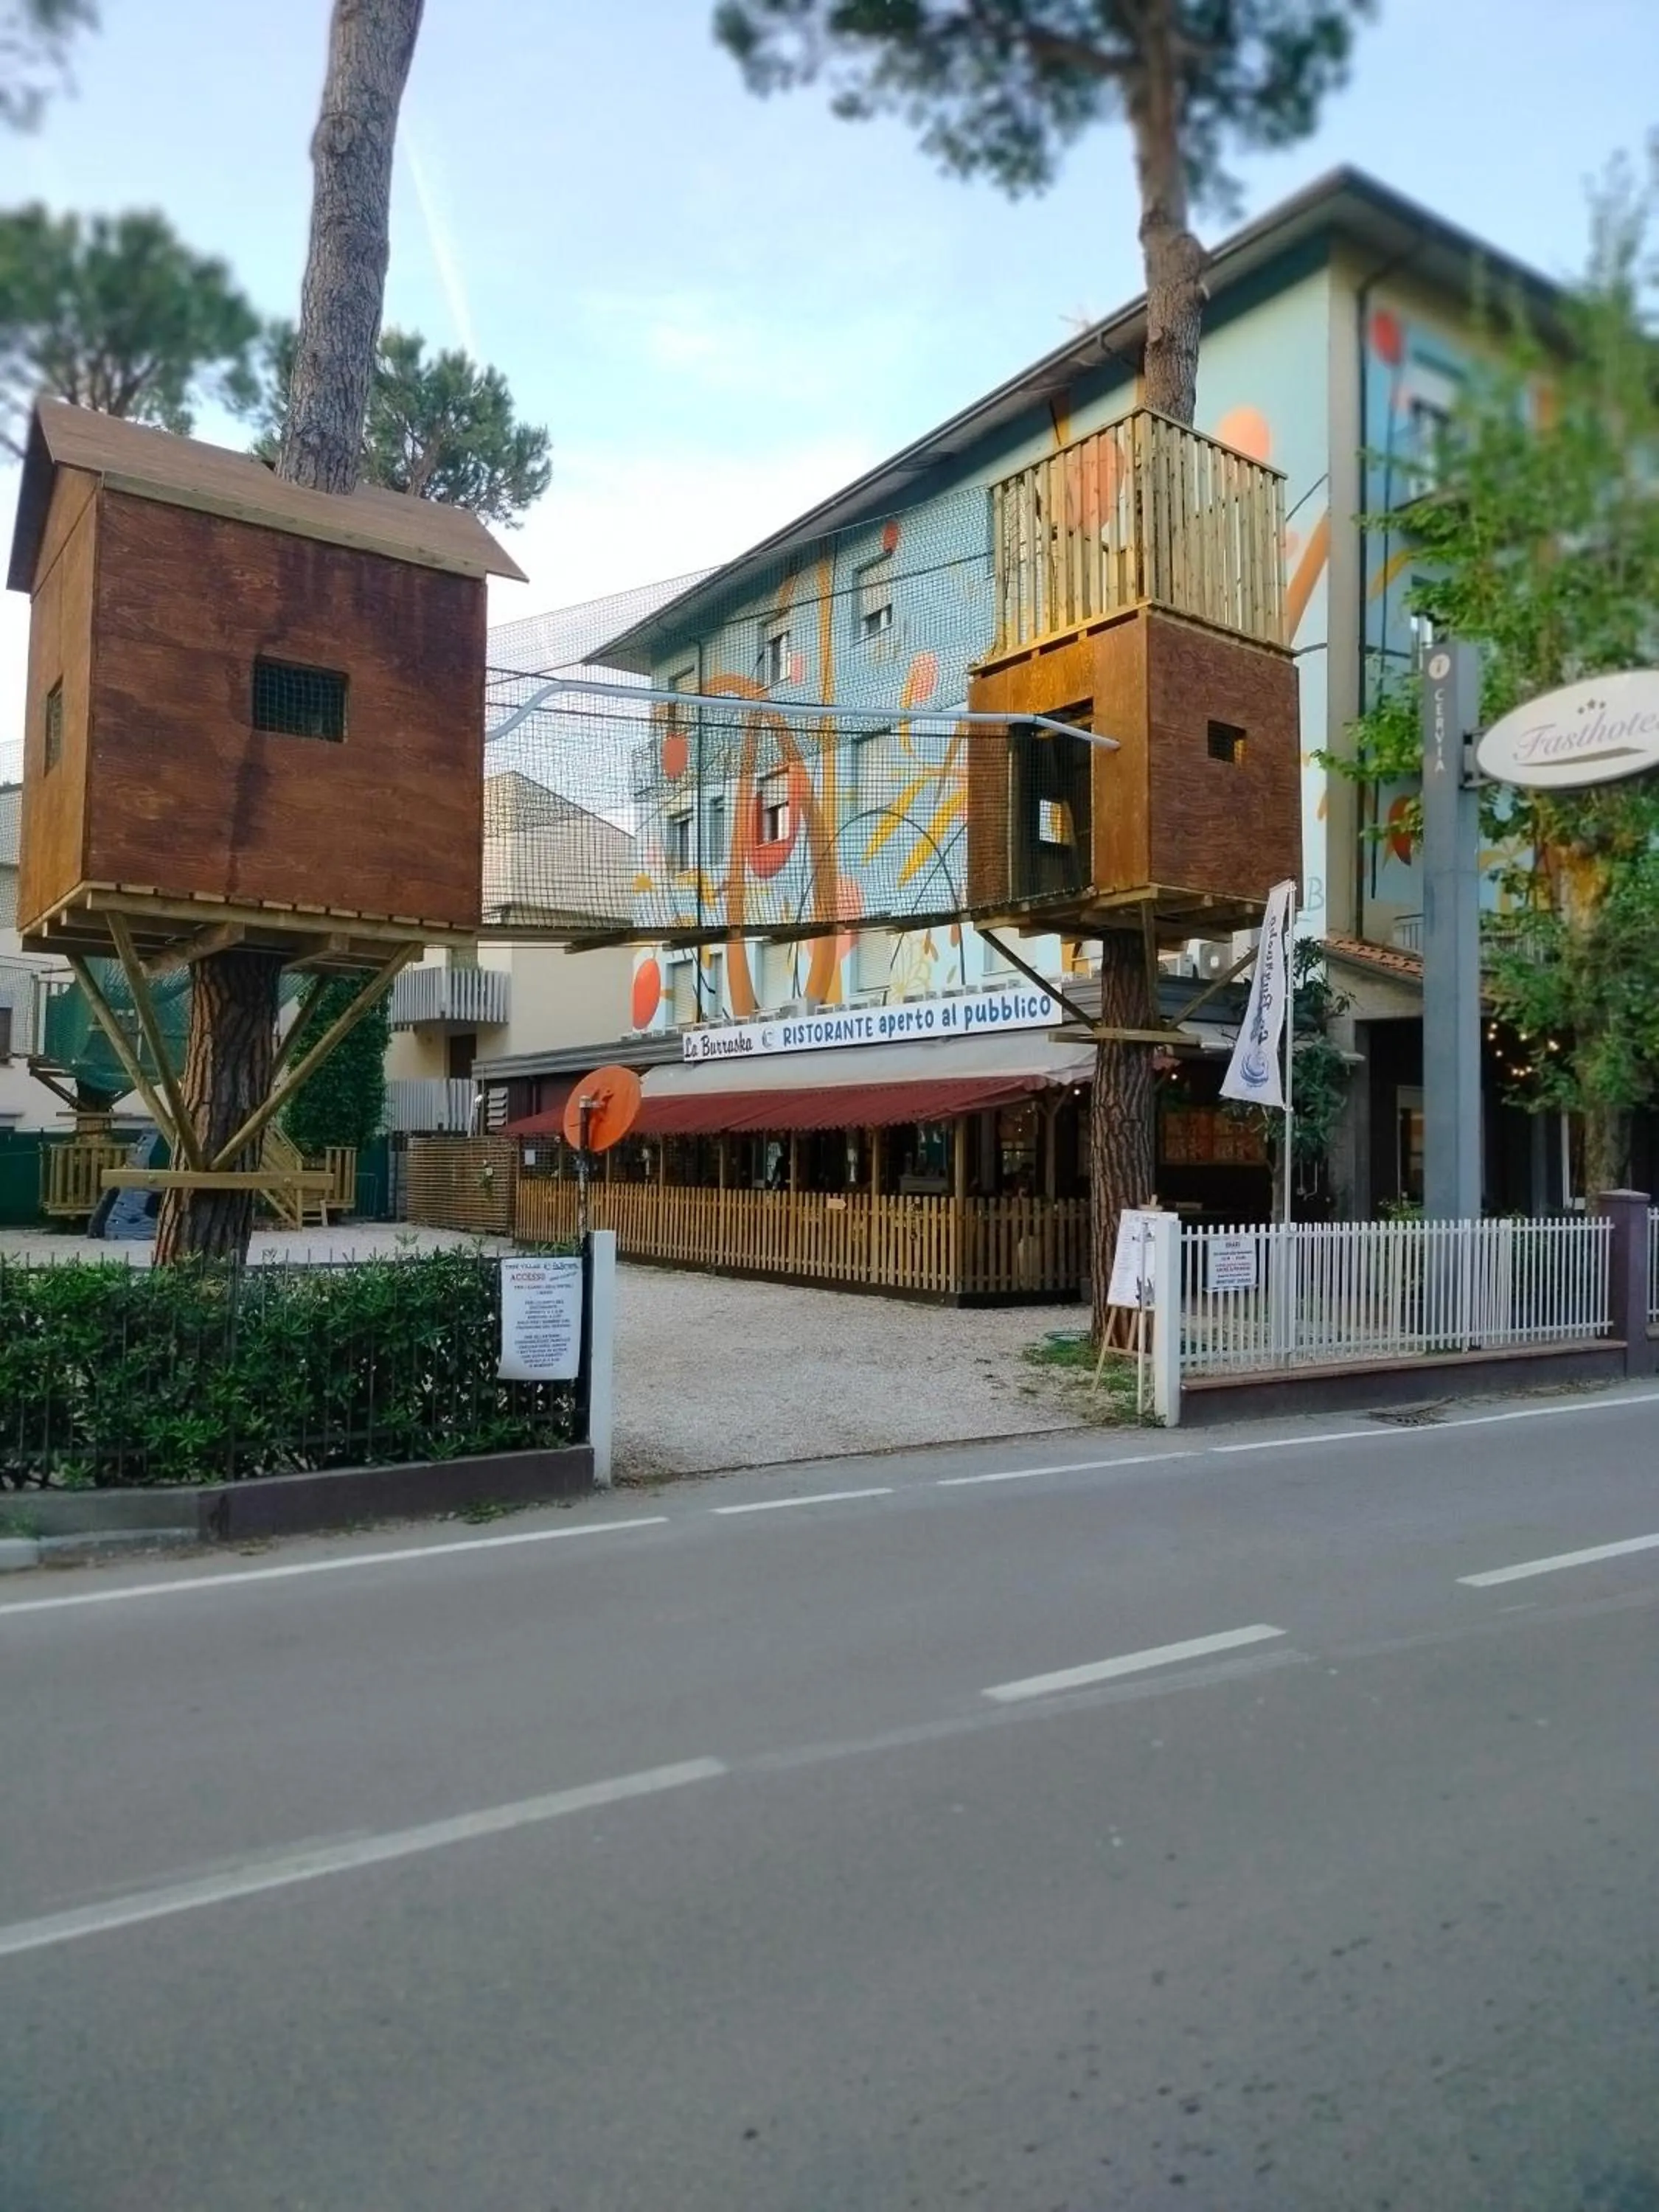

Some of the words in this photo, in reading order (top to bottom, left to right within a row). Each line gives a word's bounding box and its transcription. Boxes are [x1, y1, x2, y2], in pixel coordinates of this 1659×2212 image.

[1434, 688, 1446, 771] CERVIA
[684, 1035, 698, 1058] La
[700, 1032, 754, 1057] Burraska
[783, 1017, 874, 1047] RISTORANTE
[878, 1008, 934, 1038] aperto
[942, 1003, 957, 1027] al
[964, 995, 1051, 1031] pubblico
